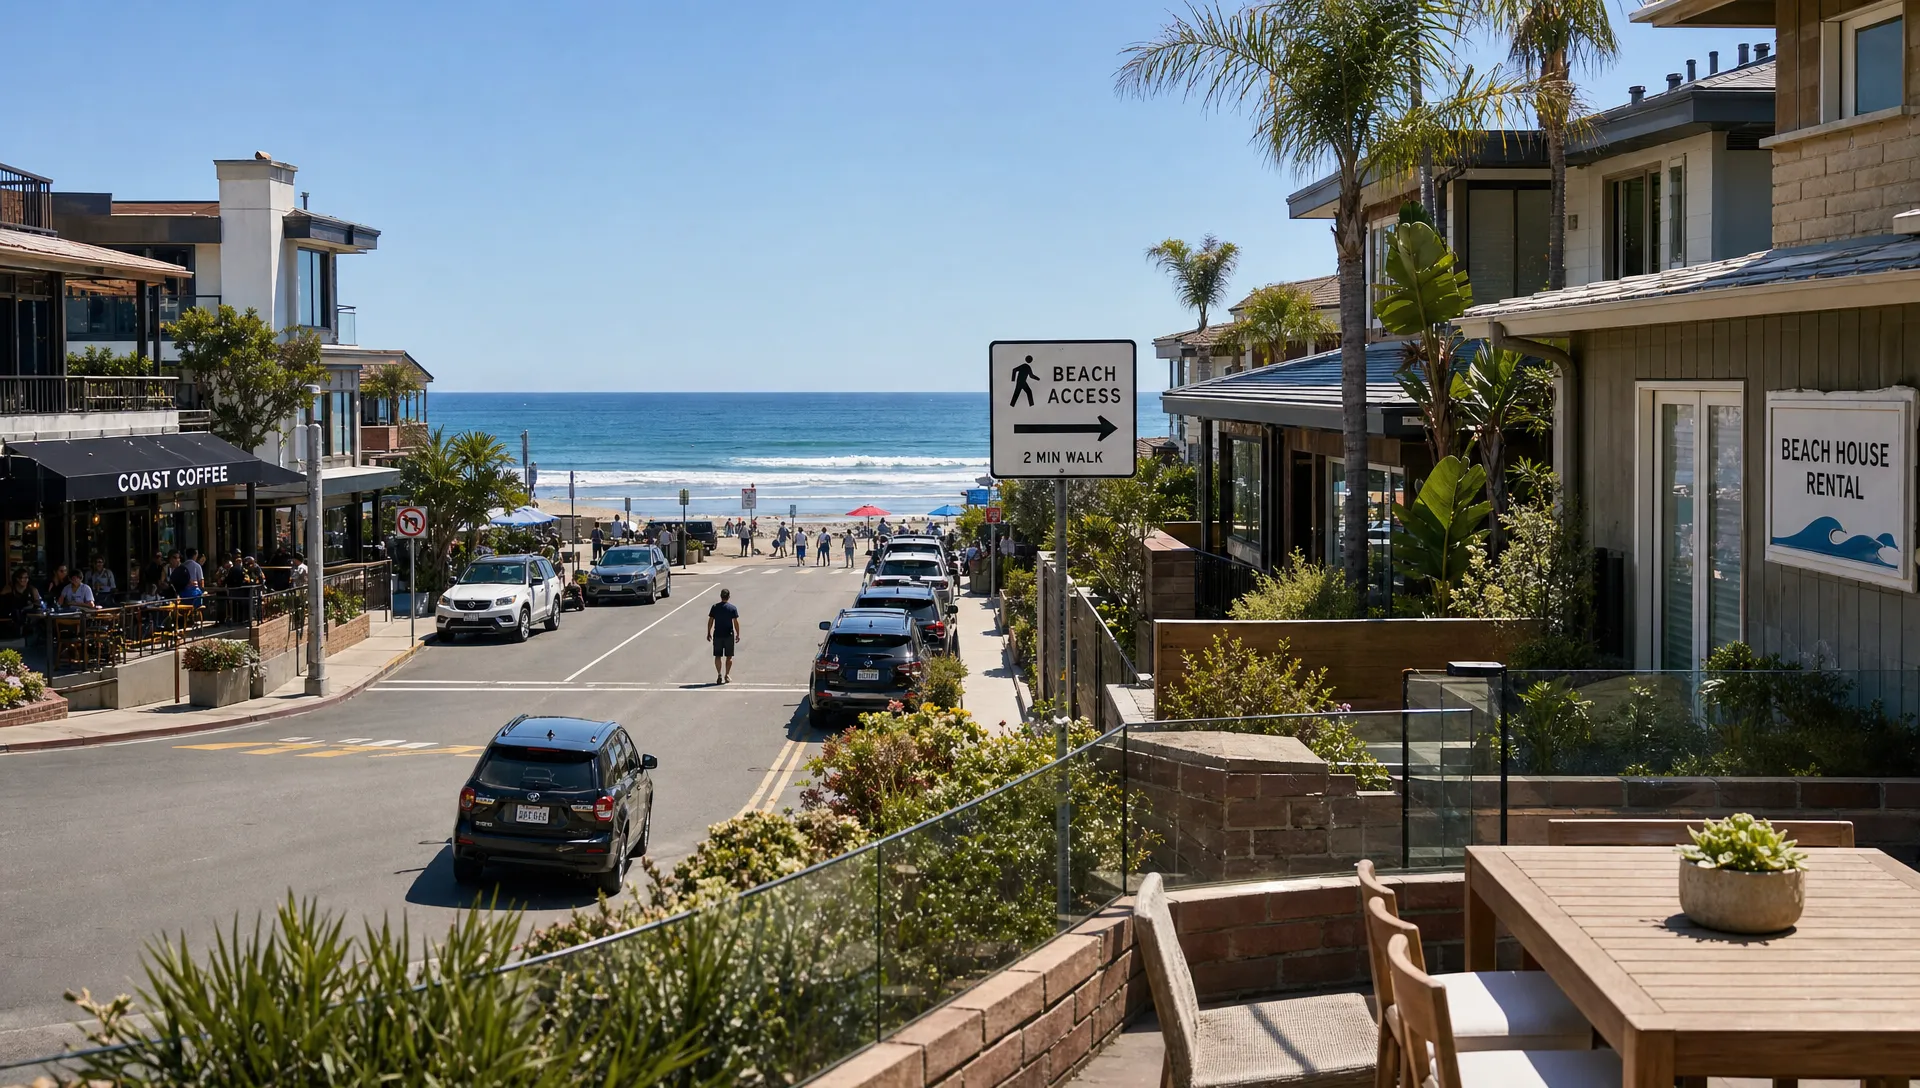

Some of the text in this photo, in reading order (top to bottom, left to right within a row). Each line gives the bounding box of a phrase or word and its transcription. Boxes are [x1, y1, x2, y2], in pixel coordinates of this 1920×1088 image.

[1053, 366, 1116, 382] BEACH
[1047, 388, 1121, 404] ACCESS
[1023, 451, 1103, 464] 2 MIN WALK
[1781, 438, 1890, 468] BEACH HOUSE
[118, 465, 228, 493] COAST COFFEE
[1806, 472, 1864, 500] RENTAL
